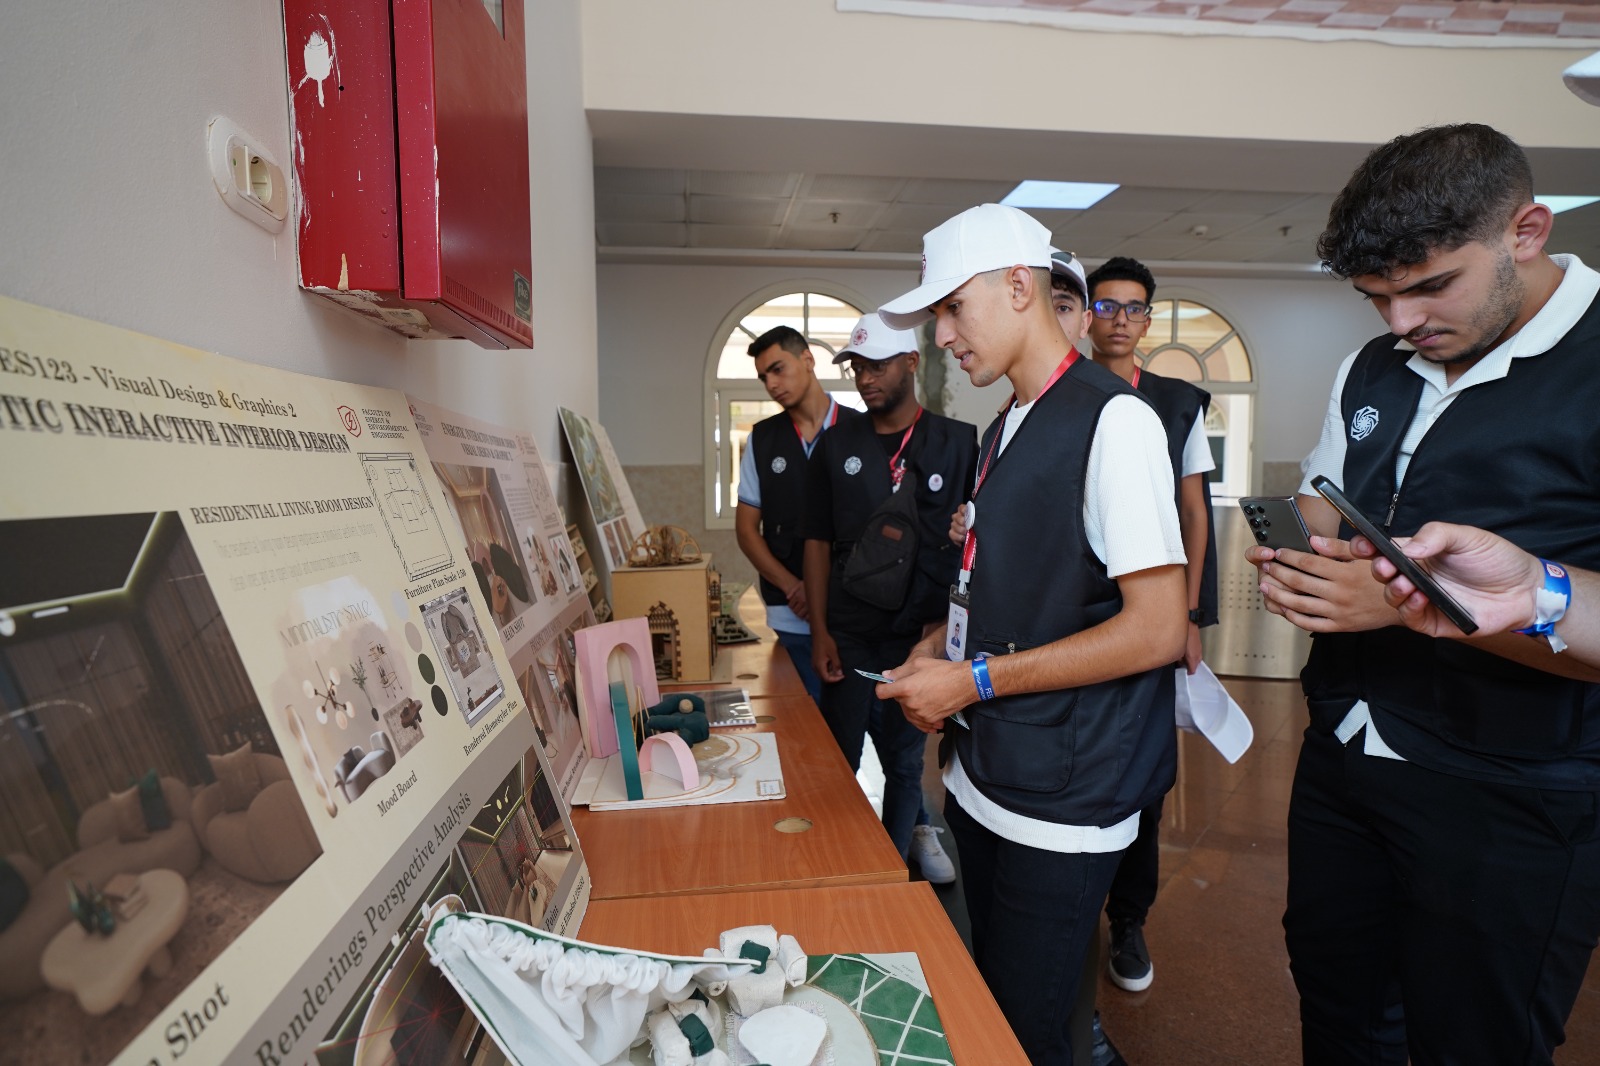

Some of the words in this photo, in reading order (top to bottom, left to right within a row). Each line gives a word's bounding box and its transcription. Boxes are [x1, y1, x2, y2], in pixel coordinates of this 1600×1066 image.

[0, 347, 77, 383] ES123
[92, 365, 156, 397] Visual
[159, 378, 216, 409] Design
[218, 390, 231, 409] &
[232, 392, 287, 418] Graphics
[287, 402, 297, 418] 2
[0, 394, 62, 429] TIC
[62, 402, 219, 442] INERACTIVE
[217, 422, 300, 450] INTERIOR
[299, 430, 350, 453] DESIGN
[190, 503, 280, 525] RESIDENTIAL
[277, 501, 315, 517] LIVING
[315, 498, 344, 514] ROOM
[342, 496, 375, 510] DESIGN
[404, 582, 433, 599] Furniture
[431, 577, 445, 589] Plan
[444, 573, 459, 585] Scale
[463, 729, 487, 757] Rendered
[506, 699, 518, 714] Plan
[377, 788, 400, 817] Mood
[396, 770, 418, 799] Board
[254, 928, 369, 1066] Renderings
[363, 838, 437, 937] Perspective
[433, 791, 473, 845] Analysis
[164, 983, 230, 1060] Shot
